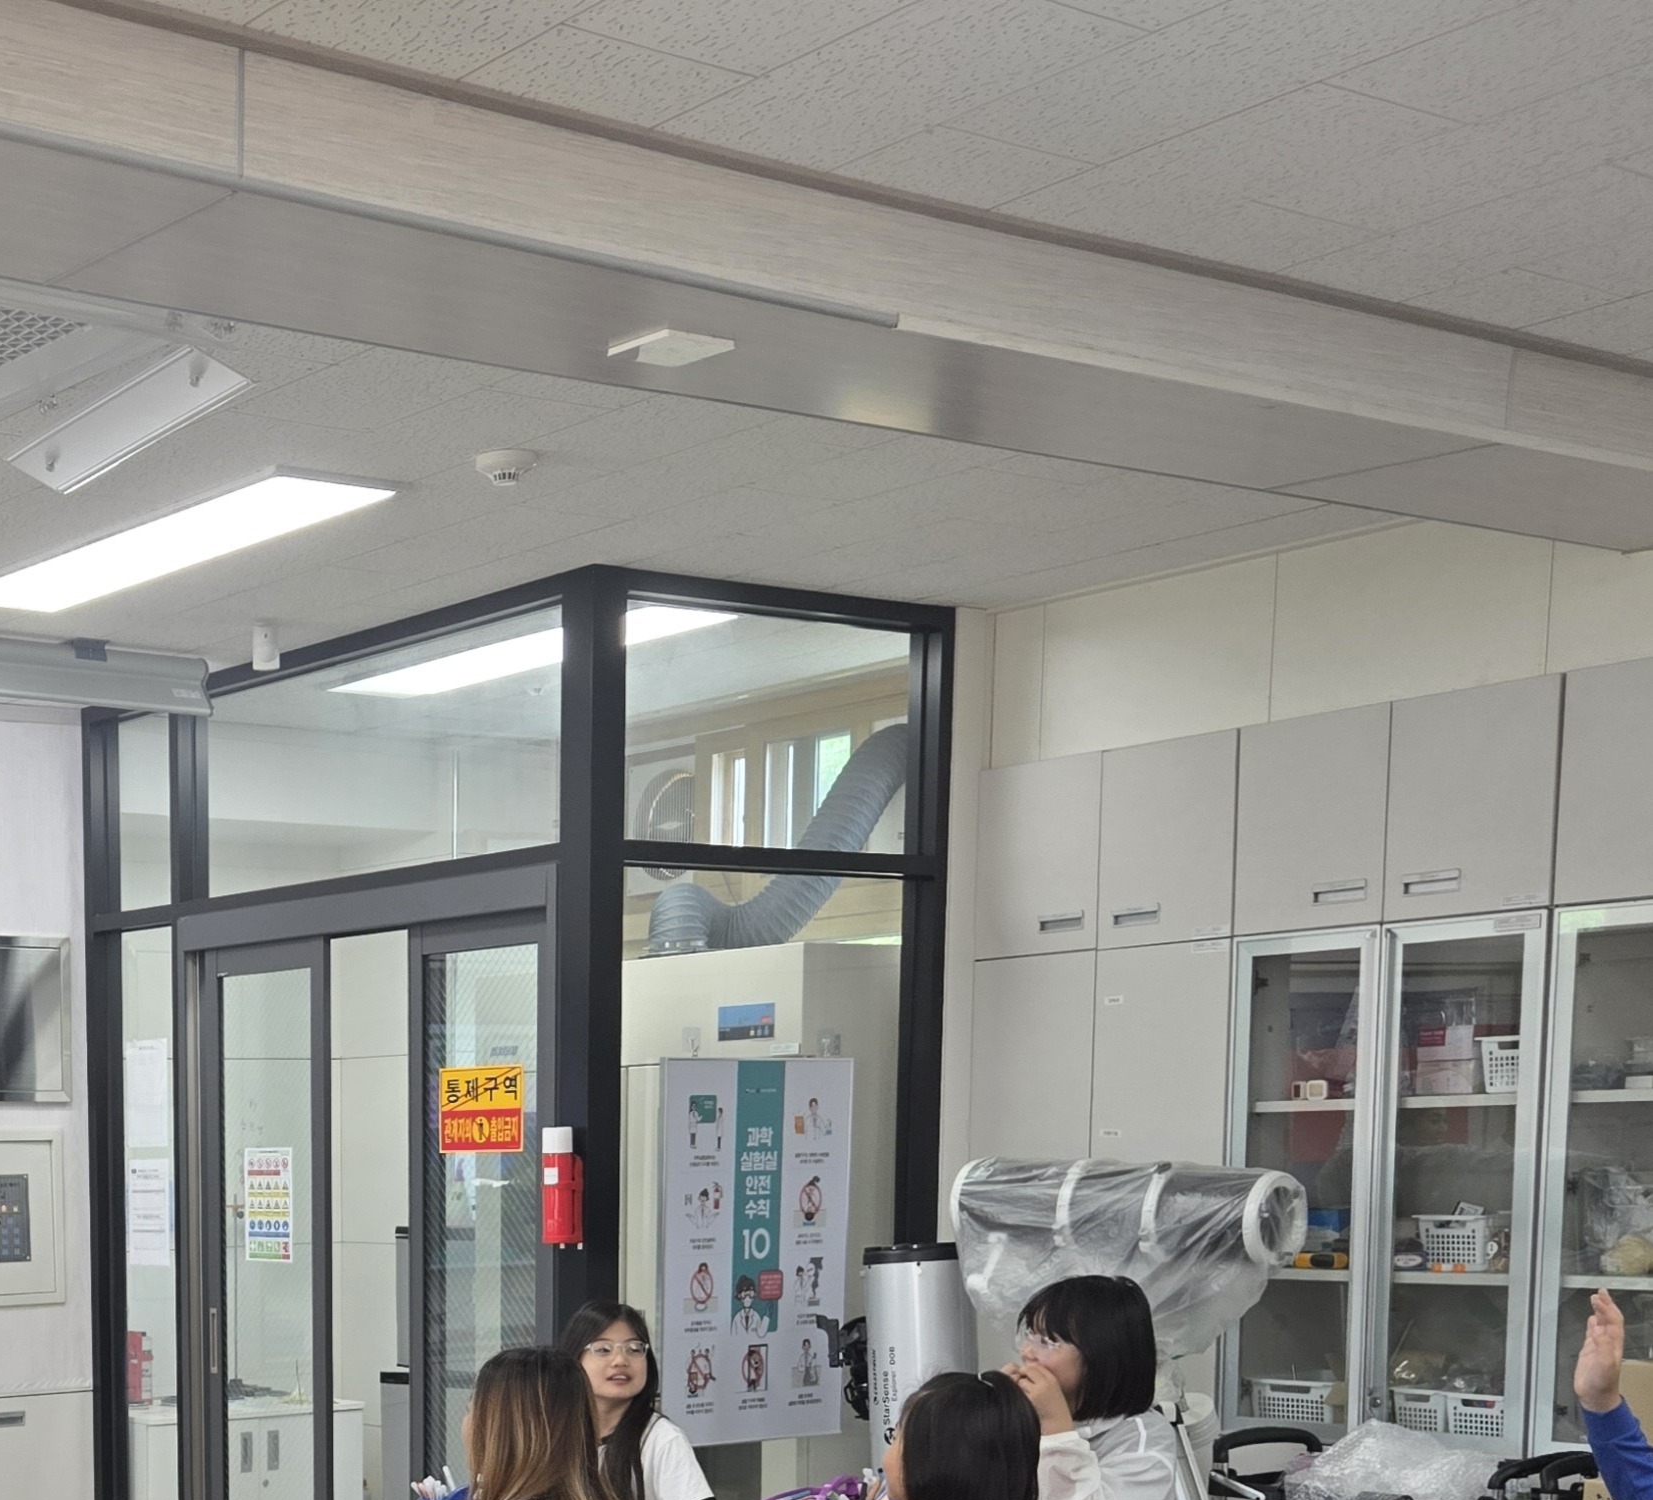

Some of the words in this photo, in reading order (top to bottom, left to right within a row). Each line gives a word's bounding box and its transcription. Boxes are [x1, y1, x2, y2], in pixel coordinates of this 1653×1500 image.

[445, 1074, 518, 1104] 통제구역
[490, 1116, 519, 1142] 출입금지
[746, 1127, 773, 1147] 과학
[740, 1151, 778, 1171] 실험실
[746, 1175, 771, 1195] 안전
[745, 1199, 770, 1219] 수칙
[742, 1227, 771, 1260] 10
[882, 1371, 891, 1425] StarSense
